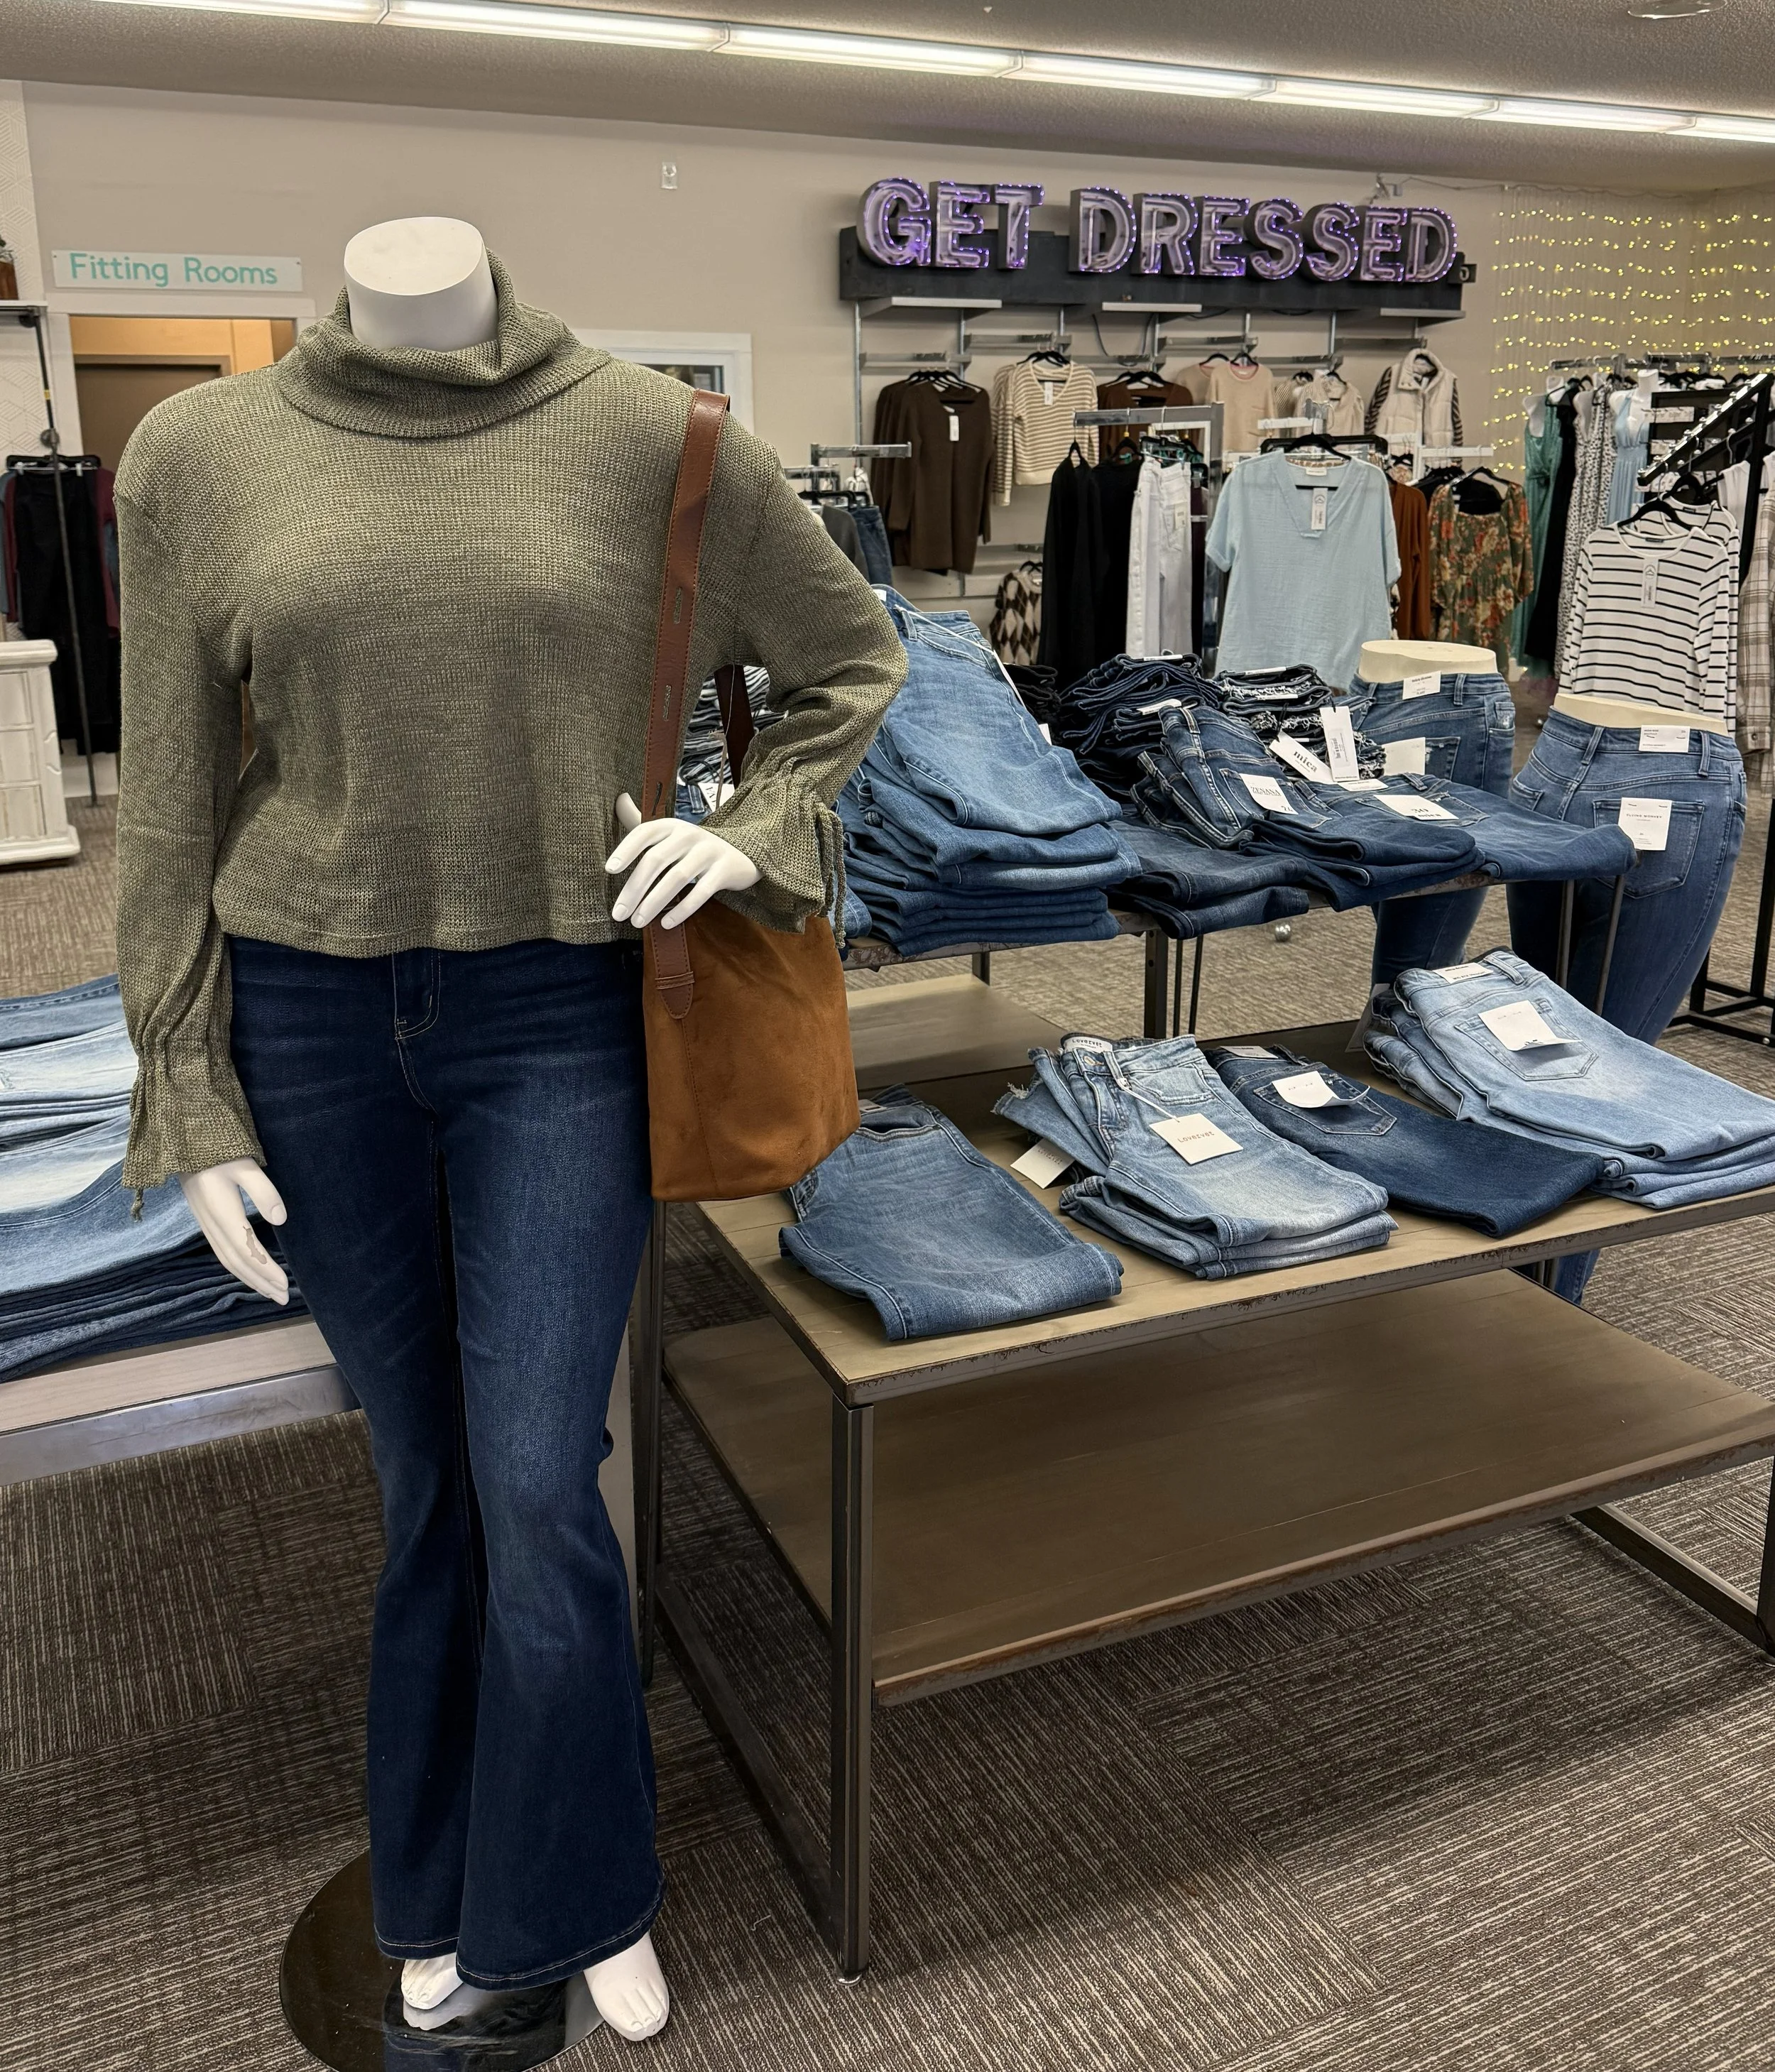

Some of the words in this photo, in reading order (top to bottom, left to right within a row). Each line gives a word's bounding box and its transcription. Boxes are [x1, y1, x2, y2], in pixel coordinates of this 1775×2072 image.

[856, 178, 1044, 269] GET
[1069, 186, 1457, 282] DRESSED
[70, 252, 169, 287] Fitting
[184, 256, 278, 285] Rooms
[1293, 751, 1318, 773] mica
